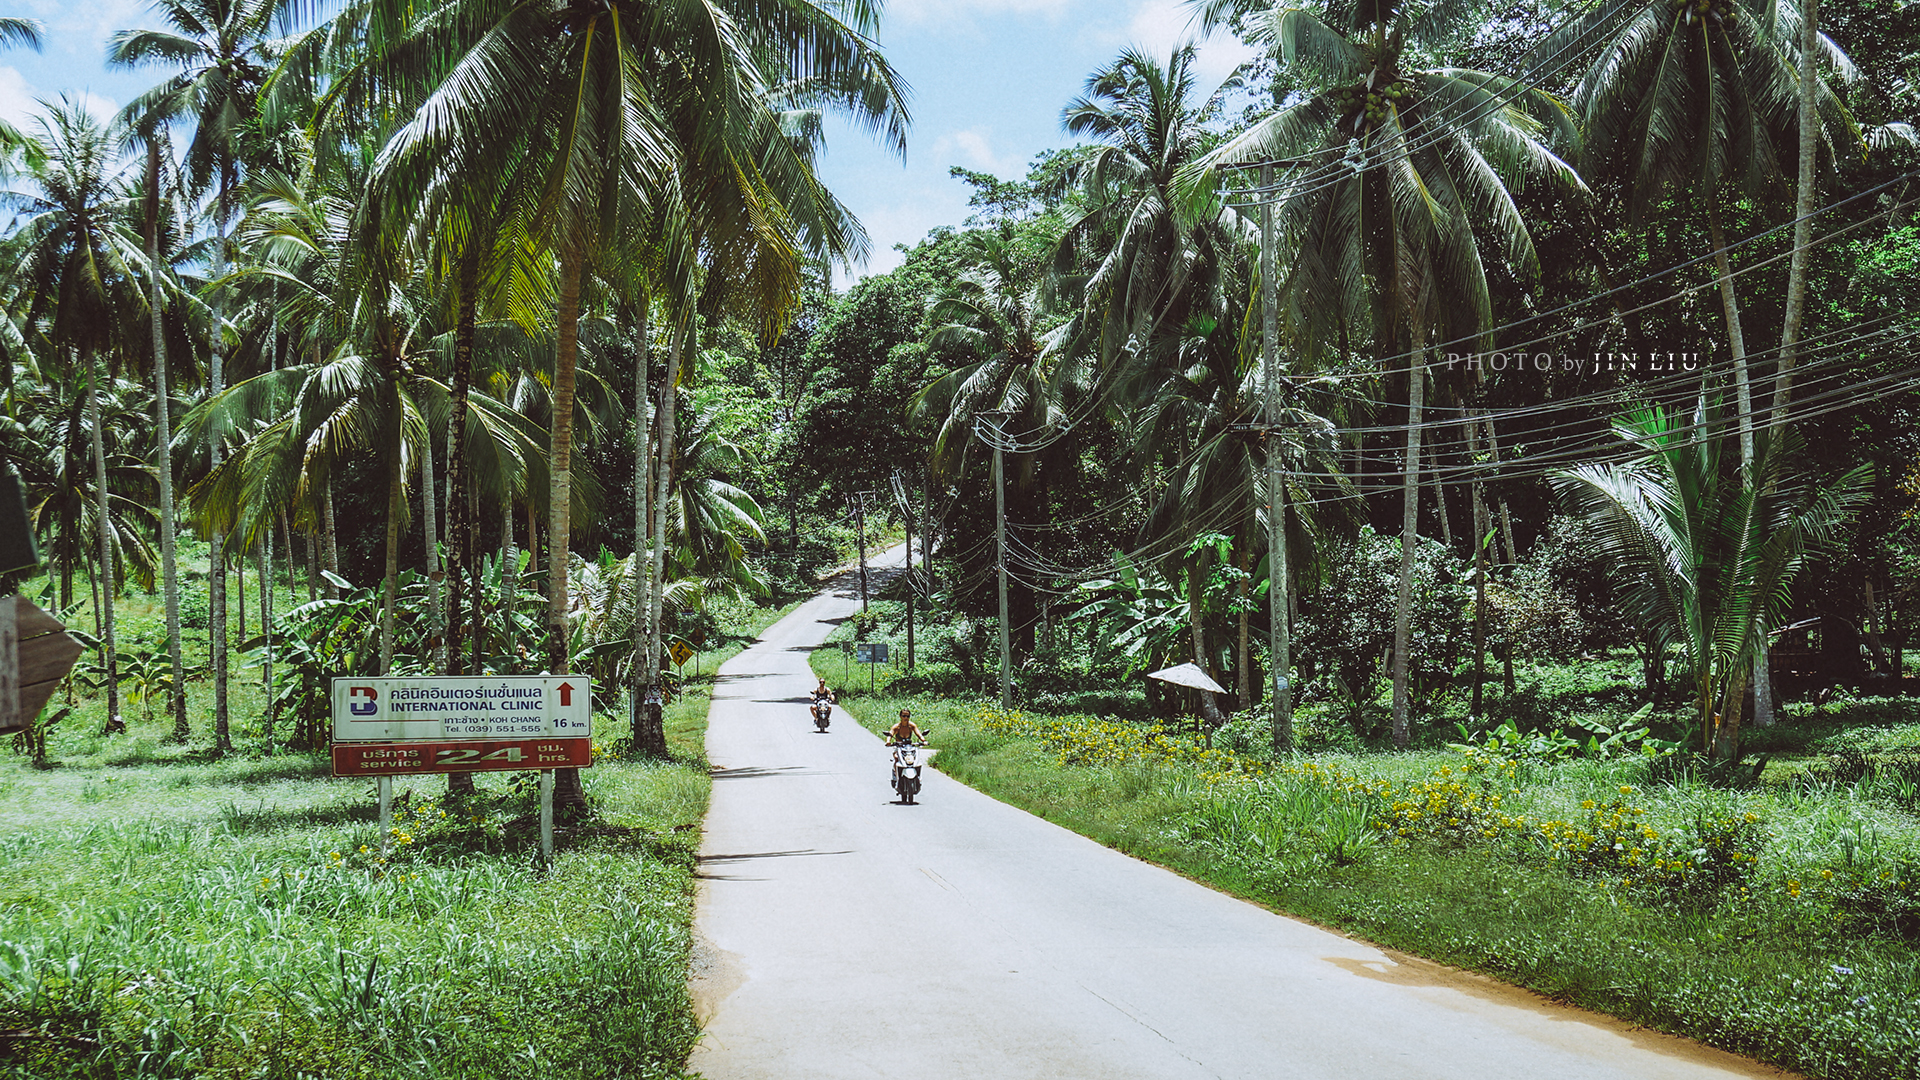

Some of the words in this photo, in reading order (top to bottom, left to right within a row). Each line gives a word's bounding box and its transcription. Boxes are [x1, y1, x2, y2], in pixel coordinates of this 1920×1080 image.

[391, 701, 496, 712] INTERNATIONAL
[501, 700, 543, 711] CLINIC
[444, 715, 479, 724] เกาะช้าง
[552, 718, 567, 728] 16
[465, 725, 493, 733] (039)
[362, 749, 419, 759] บริการ
[436, 747, 528, 765] 24
[538, 753, 570, 762] hrs.
[360, 759, 422, 769] service
